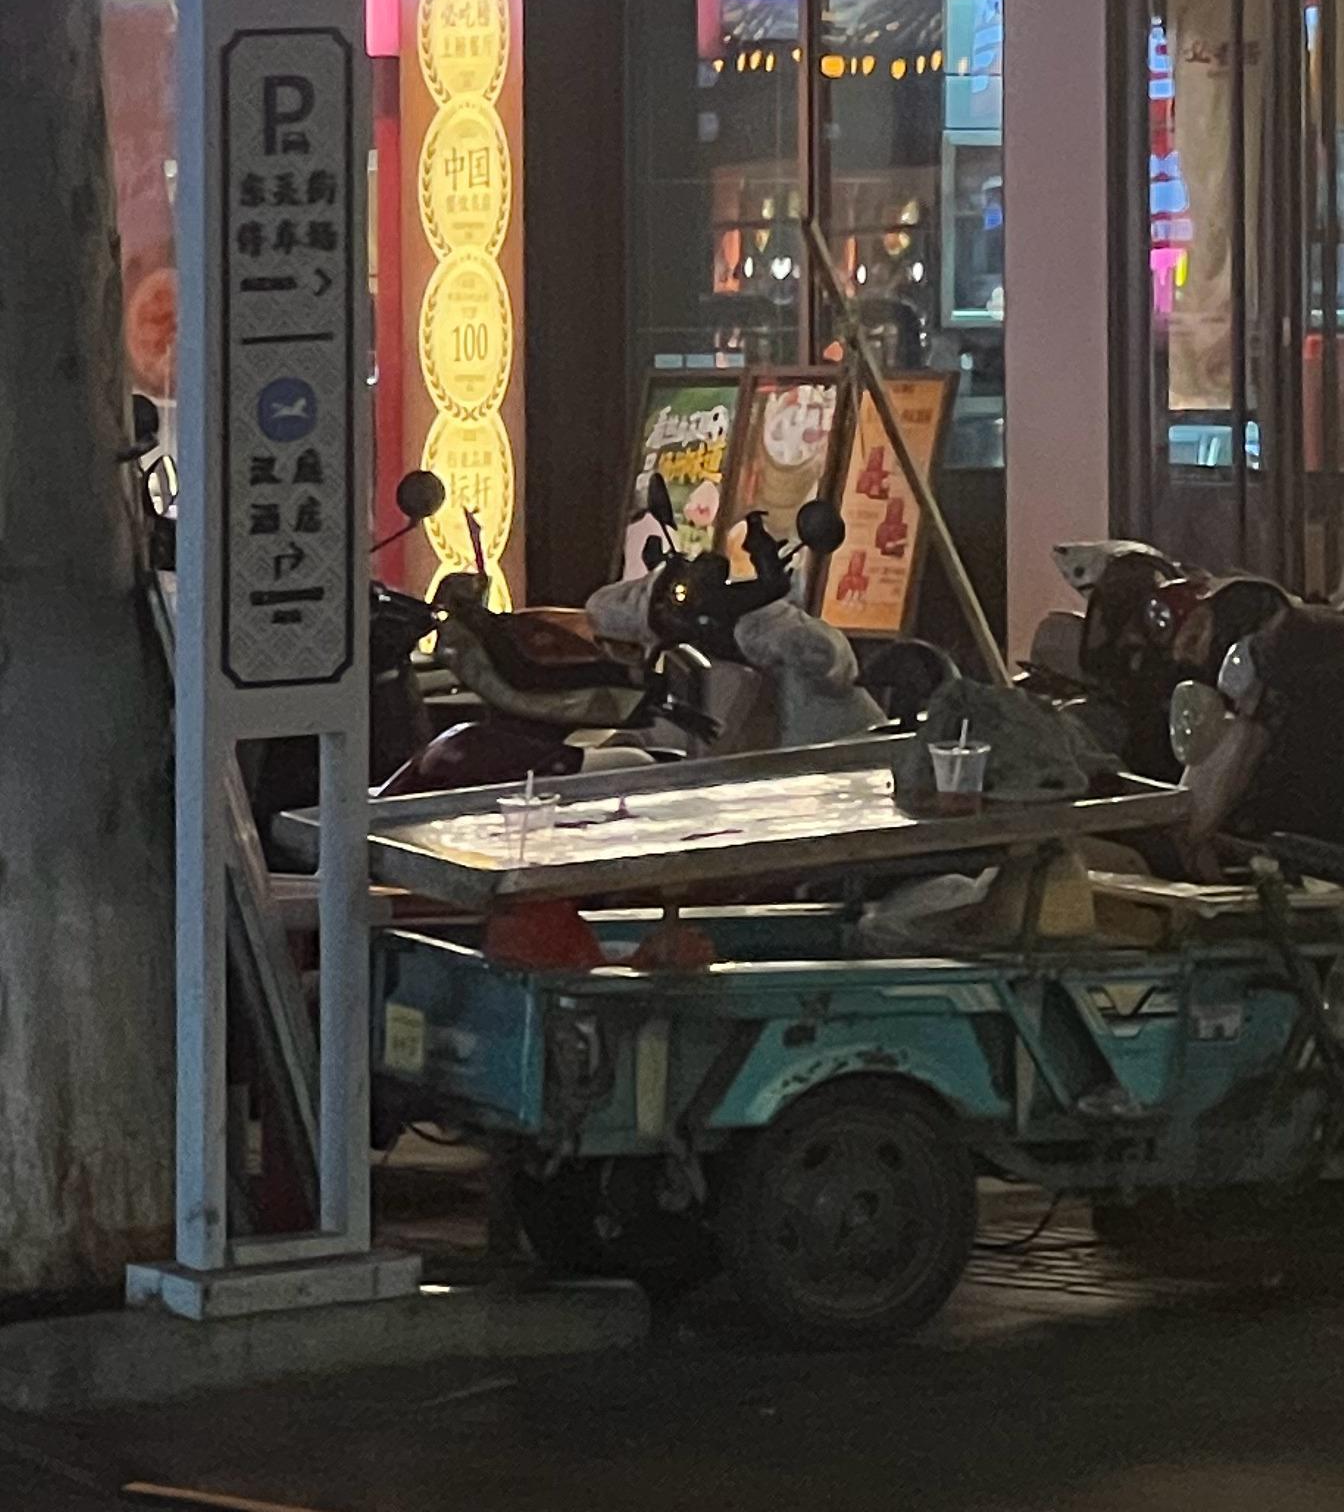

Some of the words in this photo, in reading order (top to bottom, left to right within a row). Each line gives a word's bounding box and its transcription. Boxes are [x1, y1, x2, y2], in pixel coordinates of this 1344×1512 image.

[263, 74, 315, 156] P
[443, 145, 491, 192] 中国
[452, 323, 488, 363] 100
